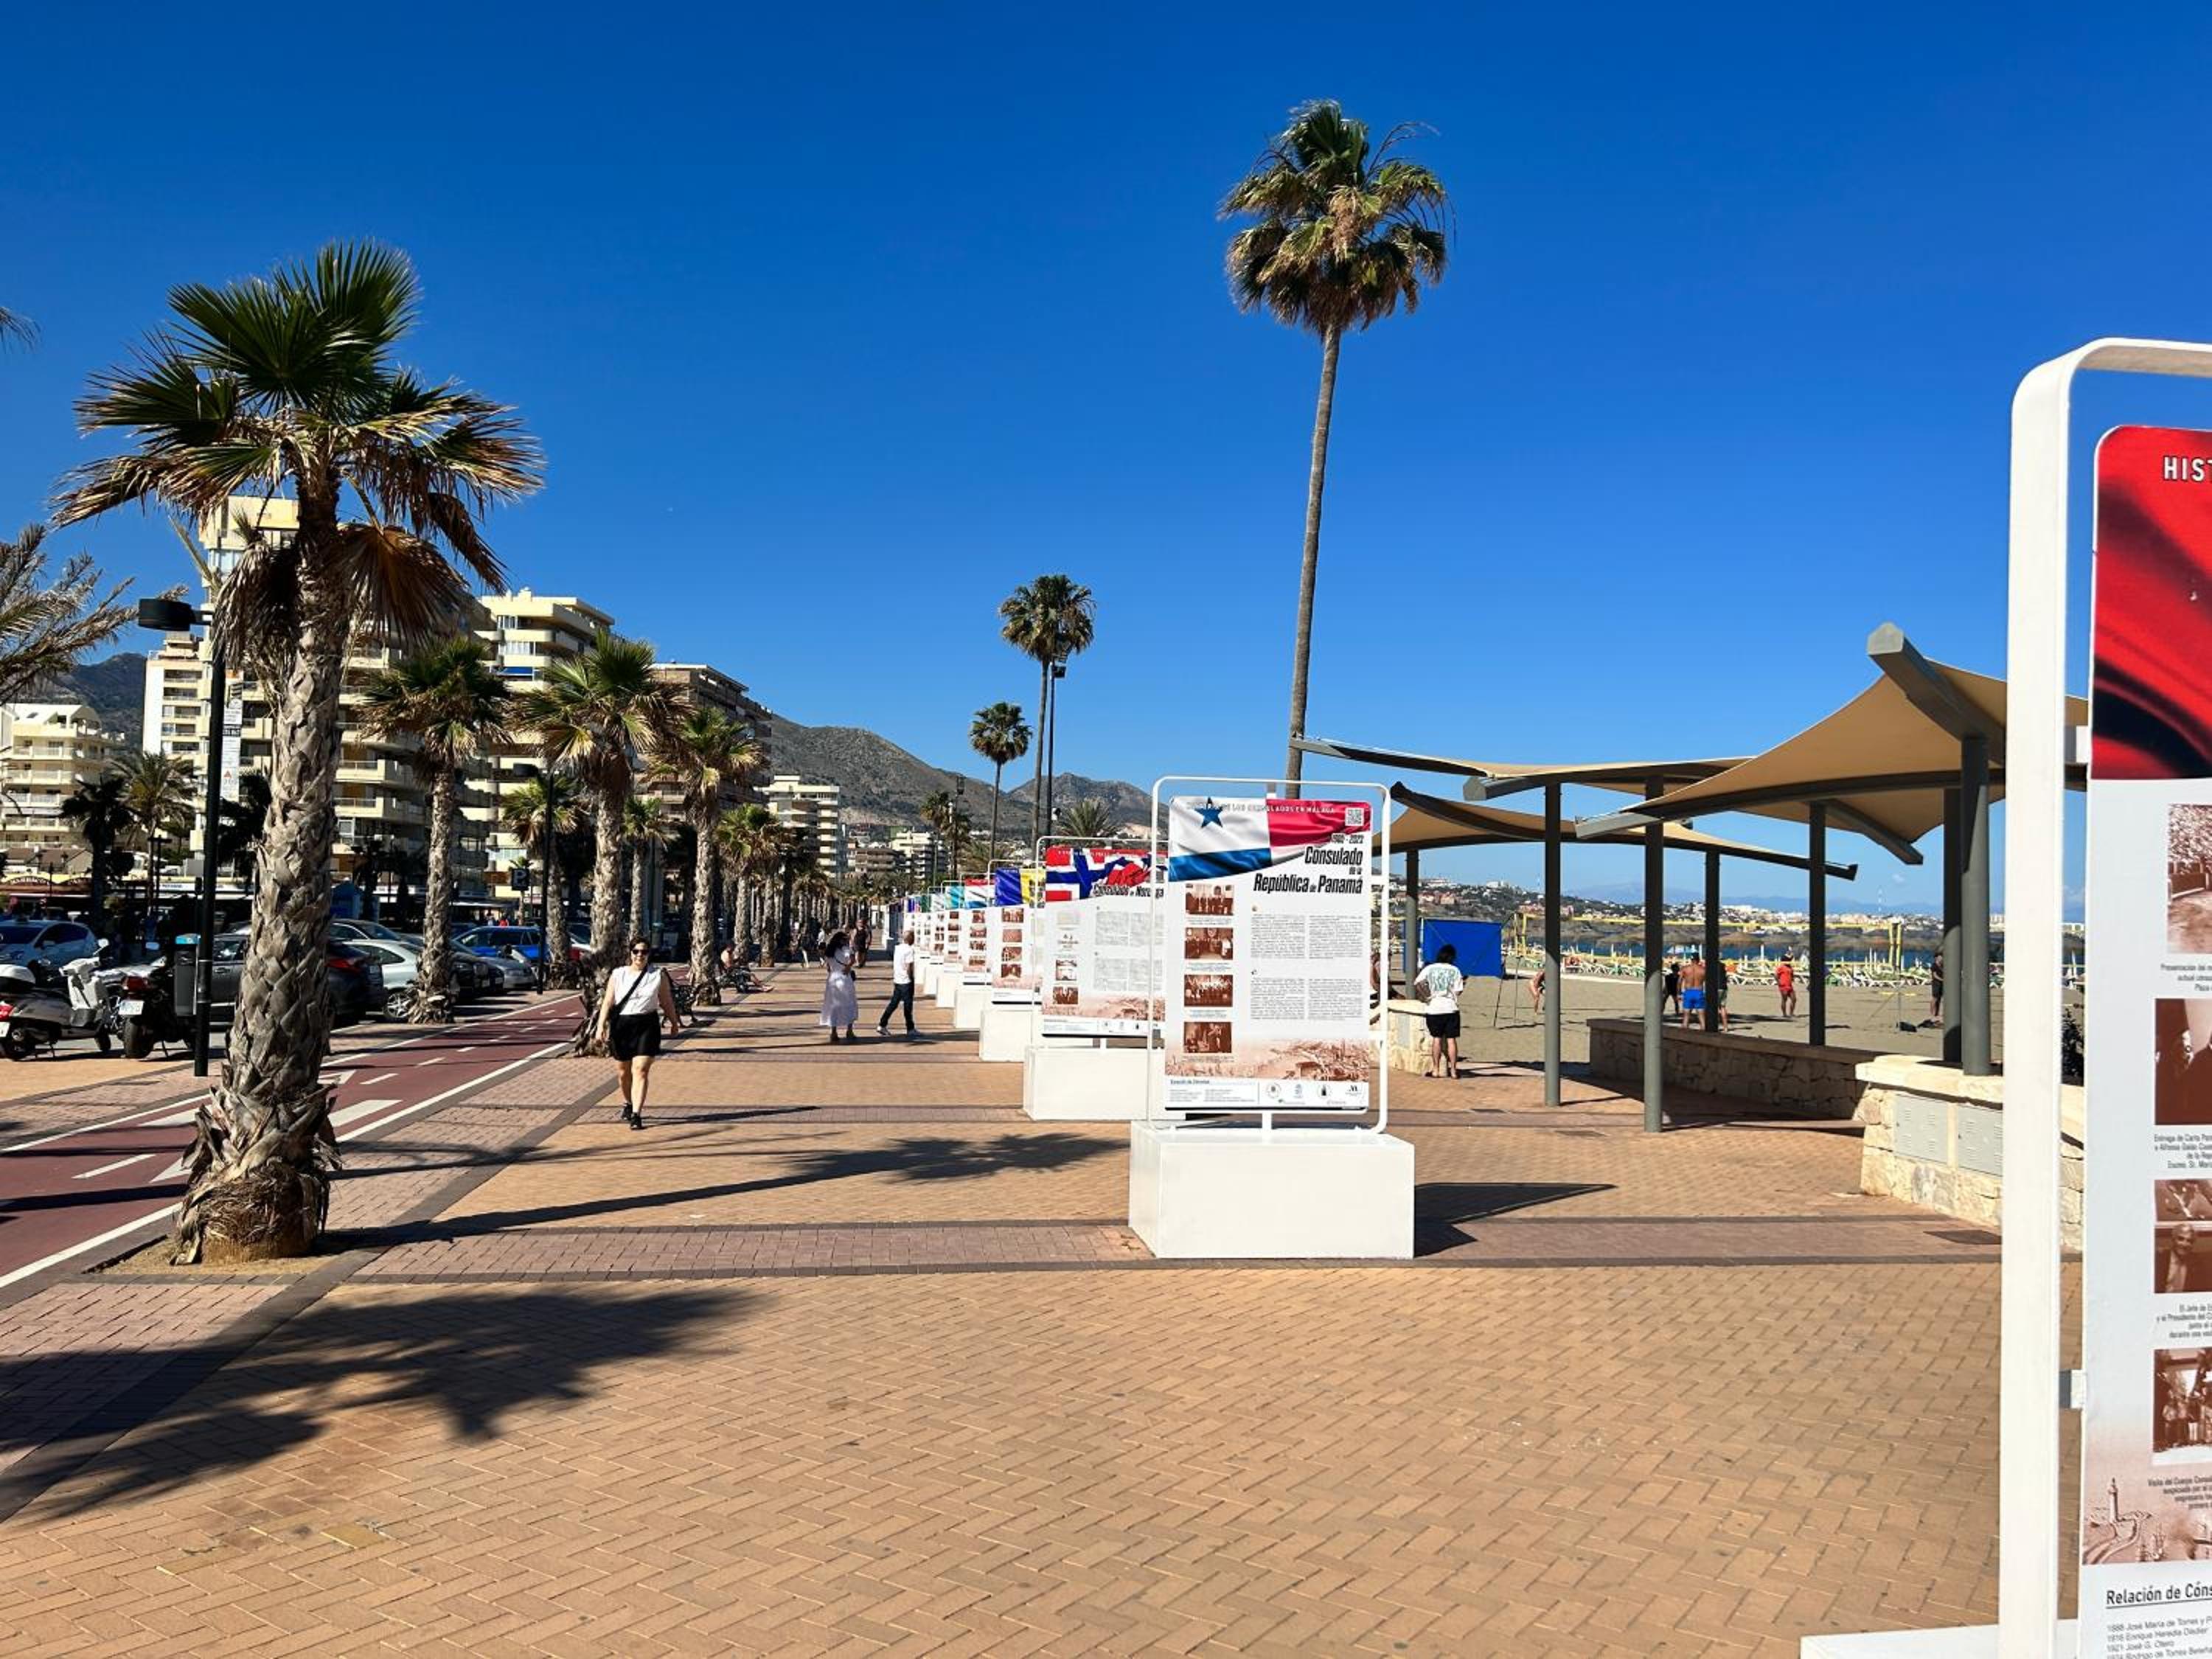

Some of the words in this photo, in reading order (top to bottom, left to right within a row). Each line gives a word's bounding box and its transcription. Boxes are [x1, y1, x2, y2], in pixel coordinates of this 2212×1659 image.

[1304, 846, 1363, 866] Consulado
[1253, 873, 1310, 894] República
[1310, 883, 1317, 893] de
[1318, 874, 1363, 894] Panamá
[2107, 1585, 2162, 1605] Relación
[2166, 1585, 2180, 1599] de
